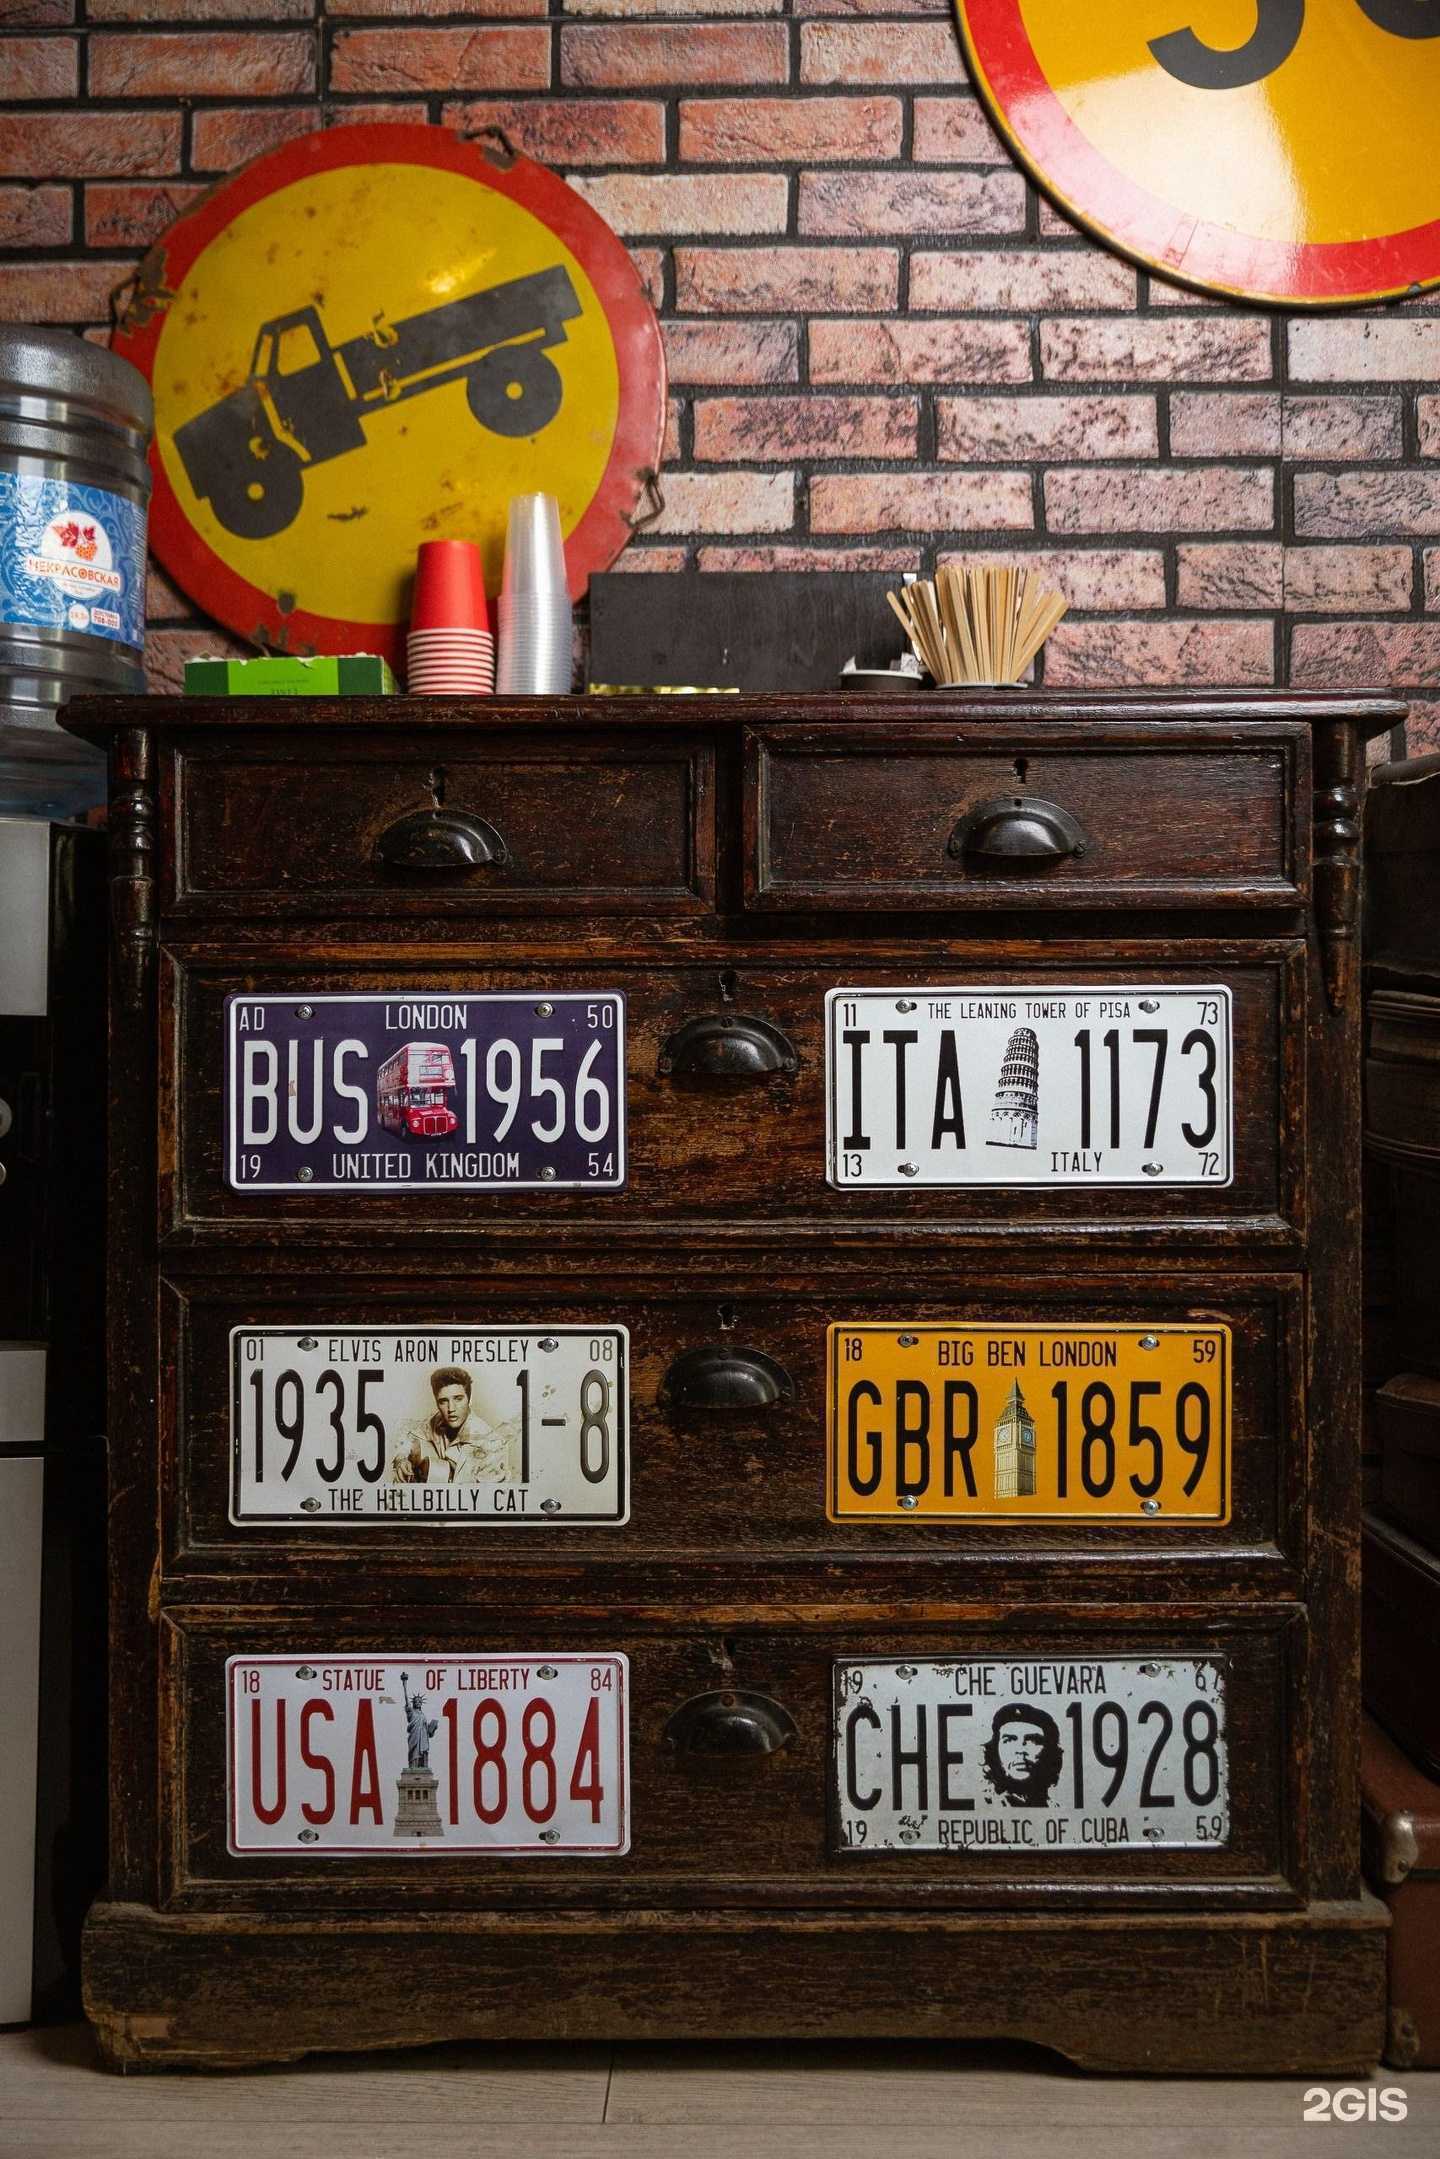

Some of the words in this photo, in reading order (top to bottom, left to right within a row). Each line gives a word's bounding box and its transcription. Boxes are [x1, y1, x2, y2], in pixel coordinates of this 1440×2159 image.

[239, 1006, 265, 1031] AD
[385, 1004, 467, 1030] LONDON
[587, 1005, 613, 1029] 50
[843, 1004, 857, 1026] 11
[928, 1002, 952, 1018] THE
[961, 1002, 1017, 1018] LEANING
[1025, 1002, 1066, 1018] TOWER
[1075, 1002, 1091, 1018] OF
[1099, 1002, 1131, 1018] PISA
[1197, 1002, 1218, 1025] 73
[243, 1039, 369, 1145] BUS
[460, 1038, 610, 1143] 1956
[843, 1029, 966, 1150] ITA
[1074, 1029, 1217, 1149] 1173
[240, 1154, 262, 1178] 19
[333, 1153, 411, 1179] UNITED
[426, 1153, 520, 1178] KINGDOM
[587, 1153, 614, 1177] 54
[843, 1154, 863, 1177] 13
[1051, 1152, 1102, 1173] ITALY
[1198, 1153, 1219, 1176] 72
[246, 1338, 264, 1361] 01
[329, 1339, 381, 1363] ELVIS
[395, 1340, 438, 1363] ARON
[451, 1339, 529, 1363] PRESLEY
[589, 1338, 613, 1361] 08
[844, 1338, 863, 1361] 18
[938, 1341, 974, 1366] BIG
[987, 1341, 1026, 1367] BEN
[1040, 1341, 1117, 1367] LONDON
[1193, 1340, 1216, 1363] 59
[250, 1369, 386, 1483] 1935
[847, 1379, 979, 1497] GBR
[1051, 1380, 1211, 1498] 1859
[328, 1489, 362, 1511] THE
[377, 1489, 479, 1511] HILLBILLY
[494, 1489, 529, 1511] CAT
[242, 1670, 260, 1694] 18
[322, 1669, 385, 1691] STATUE
[426, 1669, 446, 1690] OF
[458, 1668, 530, 1690] LIBERTY
[590, 1668, 612, 1692] 84
[955, 1667, 996, 1695] CHE
[1010, 1665, 1106, 1695] GUEVARA
[251, 1698, 383, 1825] USA
[442, 1696, 604, 1825] 1884
[846, 1703, 975, 1811] CHE
[1066, 1700, 1219, 1809] 1928
[846, 1820, 867, 1844] 19
[938, 1819, 1033, 1844] REPUBLIC
[1046, 1818, 1068, 1843] OF
[1082, 1818, 1130, 1842] CUBA
[1196, 1816, 1222, 1840] 59
